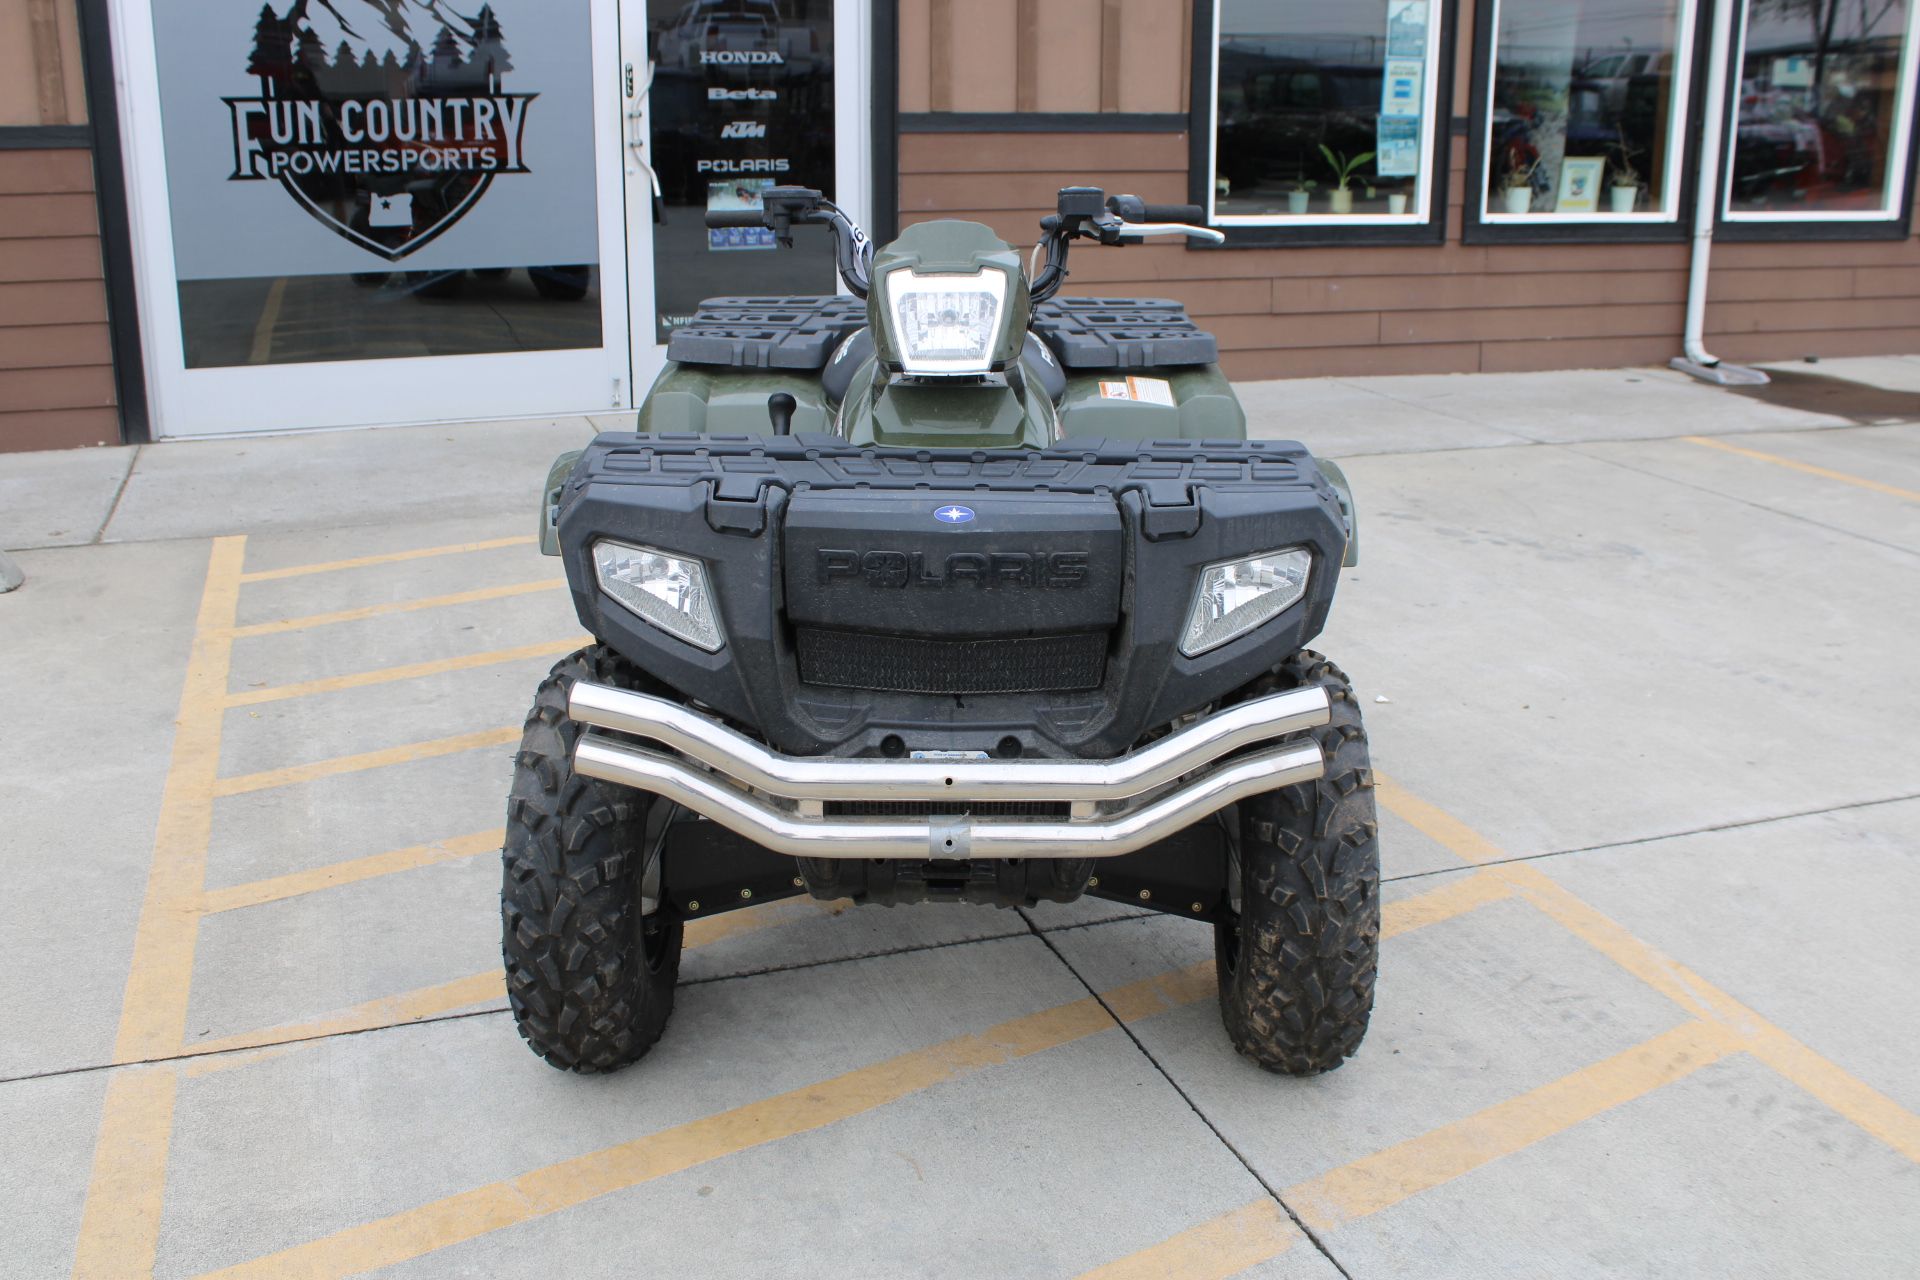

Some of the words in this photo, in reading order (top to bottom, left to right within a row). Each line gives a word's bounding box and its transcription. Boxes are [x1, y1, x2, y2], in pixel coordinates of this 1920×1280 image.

[700, 51, 784, 64] HONDA
[708, 87, 777, 100] Beta
[231, 100, 323, 177] FUN
[340, 97, 527, 170] COUNTRY
[721, 121, 766, 138] KTM
[271, 147, 498, 175] POWERSPORTS
[697, 159, 790, 172] POLARIS
[818, 548, 1090, 589] POLARIS
